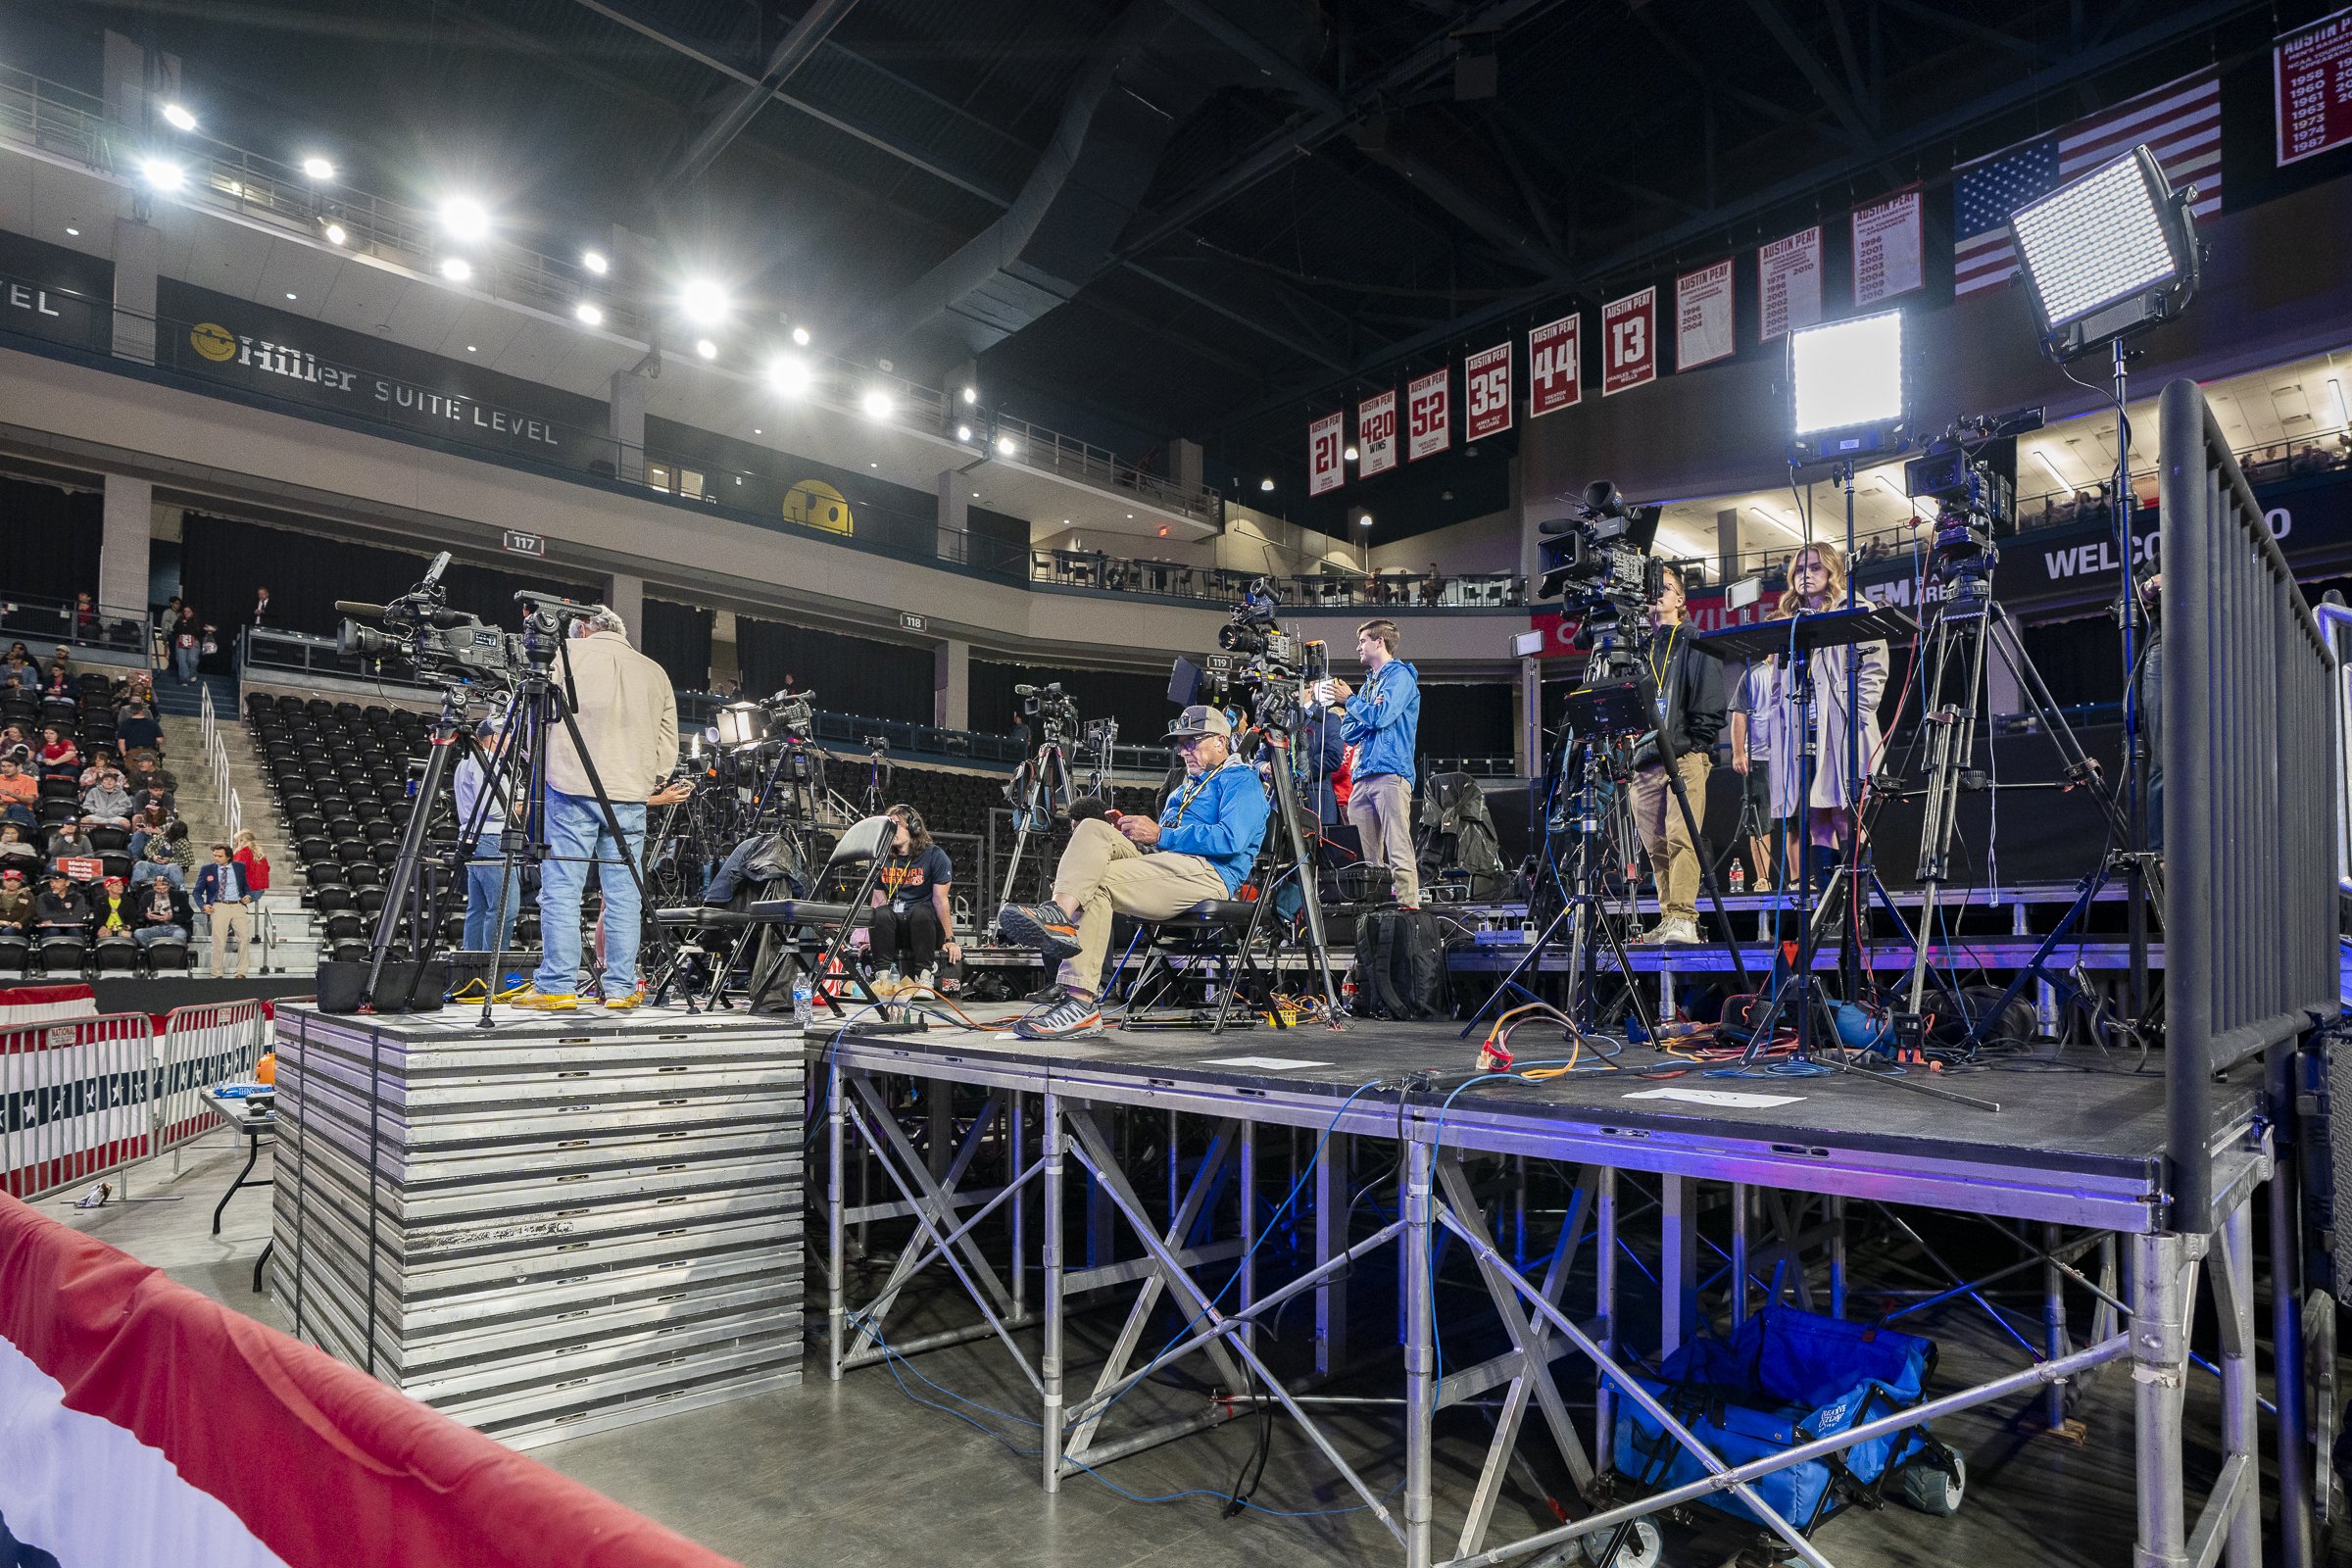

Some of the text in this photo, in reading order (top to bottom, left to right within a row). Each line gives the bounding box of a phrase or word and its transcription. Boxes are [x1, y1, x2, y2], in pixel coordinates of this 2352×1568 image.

[2290, 69, 2325, 87] 1958
[2289, 80, 2326, 99] 1960
[2292, 91, 2324, 109] 1961
[2291, 102, 2326, 120] 1963
[2292, 113, 2326, 131] 1973
[2292, 124, 2326, 142] 1974
[2293, 135, 2326, 153] 1987
[1763, 228, 1816, 260] AUSTIN PEAY
[1860, 235, 1882, 248] 1996
[1860, 245, 1883, 258] 2001
[1680, 263, 1729, 292] AUSTIN PEAY
[1793, 263, 1814, 275] 2010
[0, 280, 59, 317] EL
[1606, 292, 1651, 319] AUSTIN PEAY
[1682, 313, 1702, 324] 2003
[1683, 305, 1700, 317] 1996
[1534, 318, 1576, 344] AUSTIN PEAY
[1682, 321, 1702, 333] 2004
[1612, 316, 1644, 368] 13
[1470, 347, 1507, 370] AUSTIN PEAY
[1535, 338, 1576, 390] 44
[238, 335, 559, 445] Hiller SUITE LEVEL
[1411, 373, 1446, 394] AUSTIN PEAY
[1471, 366, 1506, 416] 35
[1361, 393, 1393, 414] AUSTIN PEAY
[1412, 391, 1445, 437] 52
[1312, 414, 1341, 433] AUSTIN PEAY
[1361, 410, 1394, 445] 420
[1316, 432, 1337, 474] 21
[1369, 439, 1386, 454] WINS
[514, 535, 535, 550] 117
[906, 616, 921, 628] 118
[1212, 658, 1227, 667] 119
[238, 1087, 255, 1096] THINS
